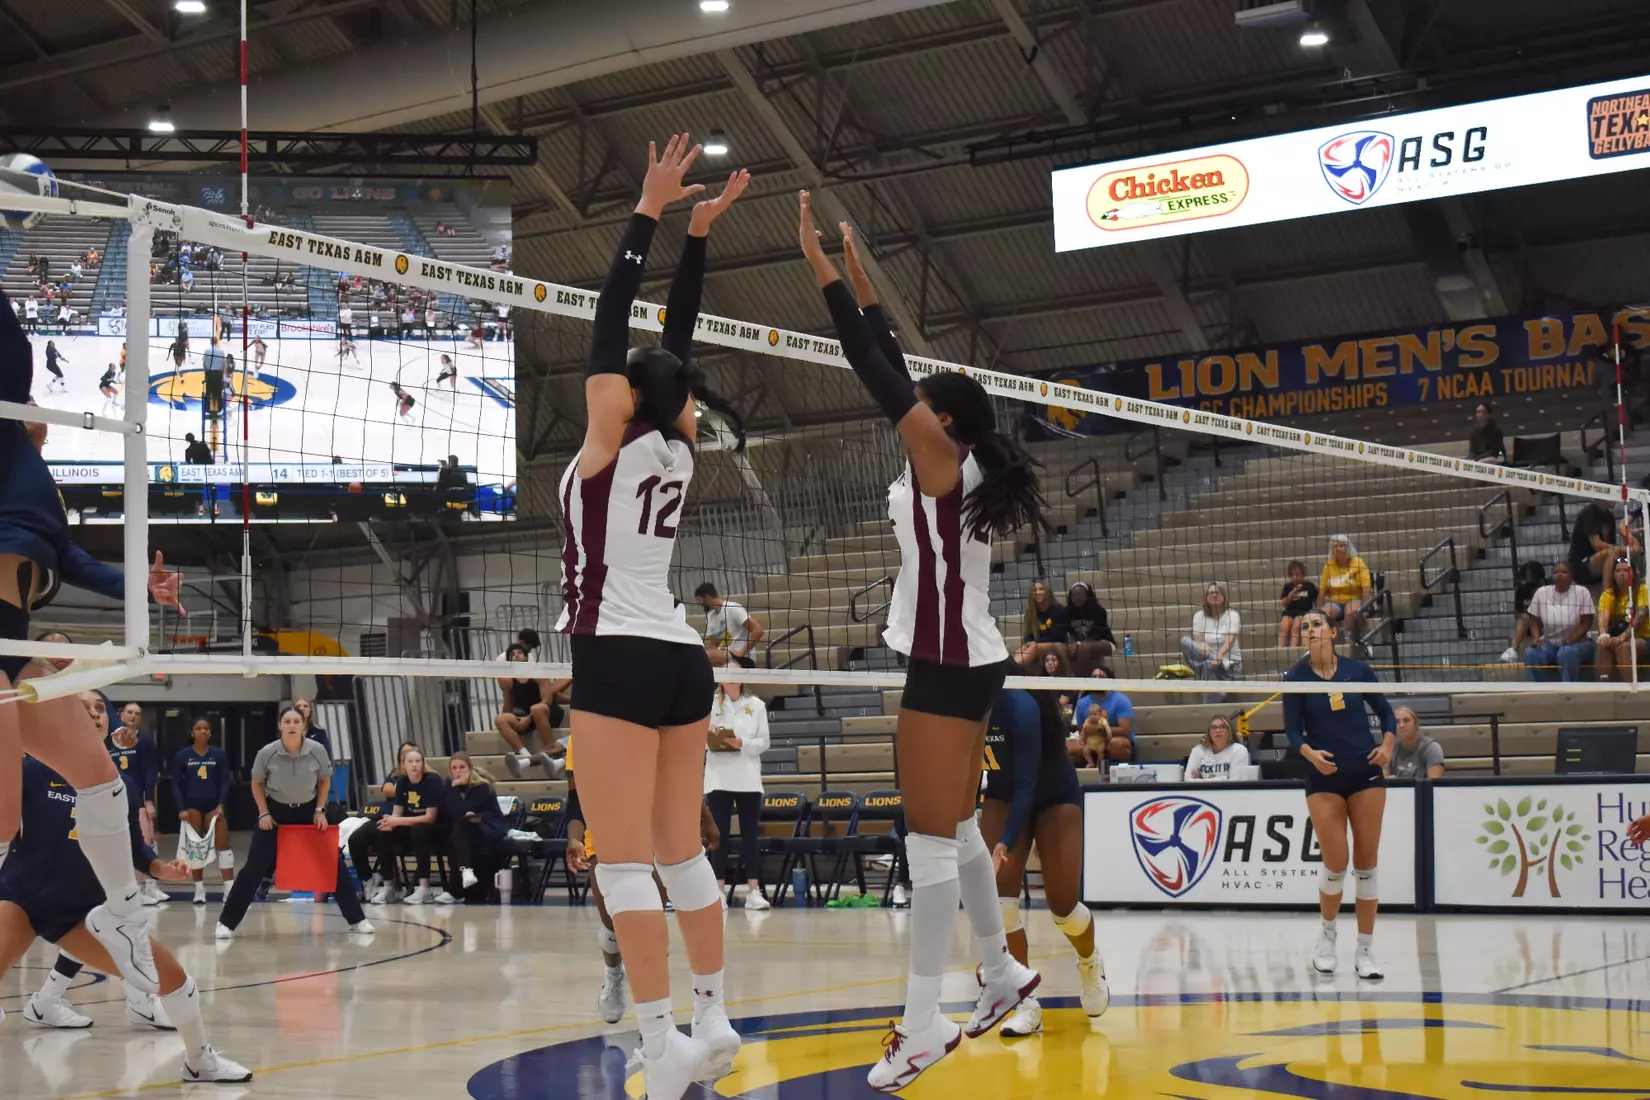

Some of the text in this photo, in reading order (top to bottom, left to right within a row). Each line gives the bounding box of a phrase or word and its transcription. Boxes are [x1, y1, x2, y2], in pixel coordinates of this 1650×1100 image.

[1398, 126, 1487, 172] ASG
[1108, 169, 1225, 202] Chicken
[1168, 192, 1228, 212] EXPRESS
[152, 204, 176, 216] Senoh
[268, 230, 383, 266] EAST TEXAS A&M
[421, 262, 524, 296] EAST TEXAS A&M
[556, 290, 584, 307] EAST
[628, 305, 648, 320] &M
[706, 320, 737, 336] TEXAS
[740, 326, 760, 341] A&M
[786, 335, 810, 350] EAST
[813, 342, 840, 356] TEXAS
[1145, 308, 1650, 400] LION MEN'S BAS
[908, 360, 932, 374] TEXAS
[972, 372, 1034, 392] EAST TEXAS A&M
[1417, 378, 1429, 402] 7
[1437, 371, 1494, 400] NCAA
[1054, 387, 1108, 408] EAST TEXAS A&M
[1229, 382, 1388, 418] CHAMPIONSHIPS
[1127, 402, 1143, 414] EAST
[1144, 406, 1164, 418] TEXAS
[1194, 414, 1209, 425] EAST
[1211, 417, 1228, 429] TEXAS
[1256, 425, 1270, 437] EAST
[52, 468, 99, 477] ILLINOIS
[181, 468, 200, 476] EAST
[203, 468, 227, 476] TEXAS
[273, 469, 288, 478] 14
[298, 469, 317, 478] TIED
[336, 469, 362, 478] (BEST
[366, 469, 378, 478] OF
[380, 469, 389, 478] 5)
[636, 474, 683, 538] 12
[1328, 692, 1345, 711] 2
[119, 755, 128, 770] 3
[197, 766, 207, 779] 4
[48, 790, 76, 803] EAST
[764, 797, 798, 807] LIONS
[819, 797, 851, 807] LIONS
[864, 796, 901, 807] LIONS
[364, 806, 380, 814] LIO
[531, 802, 561, 812] LIONS
[1597, 792, 1650, 823] Hu
[1261, 868, 1318, 876] SYSTEM
[1222, 881, 1283, 889] HVAC-R
[1599, 868, 1650, 899] He
